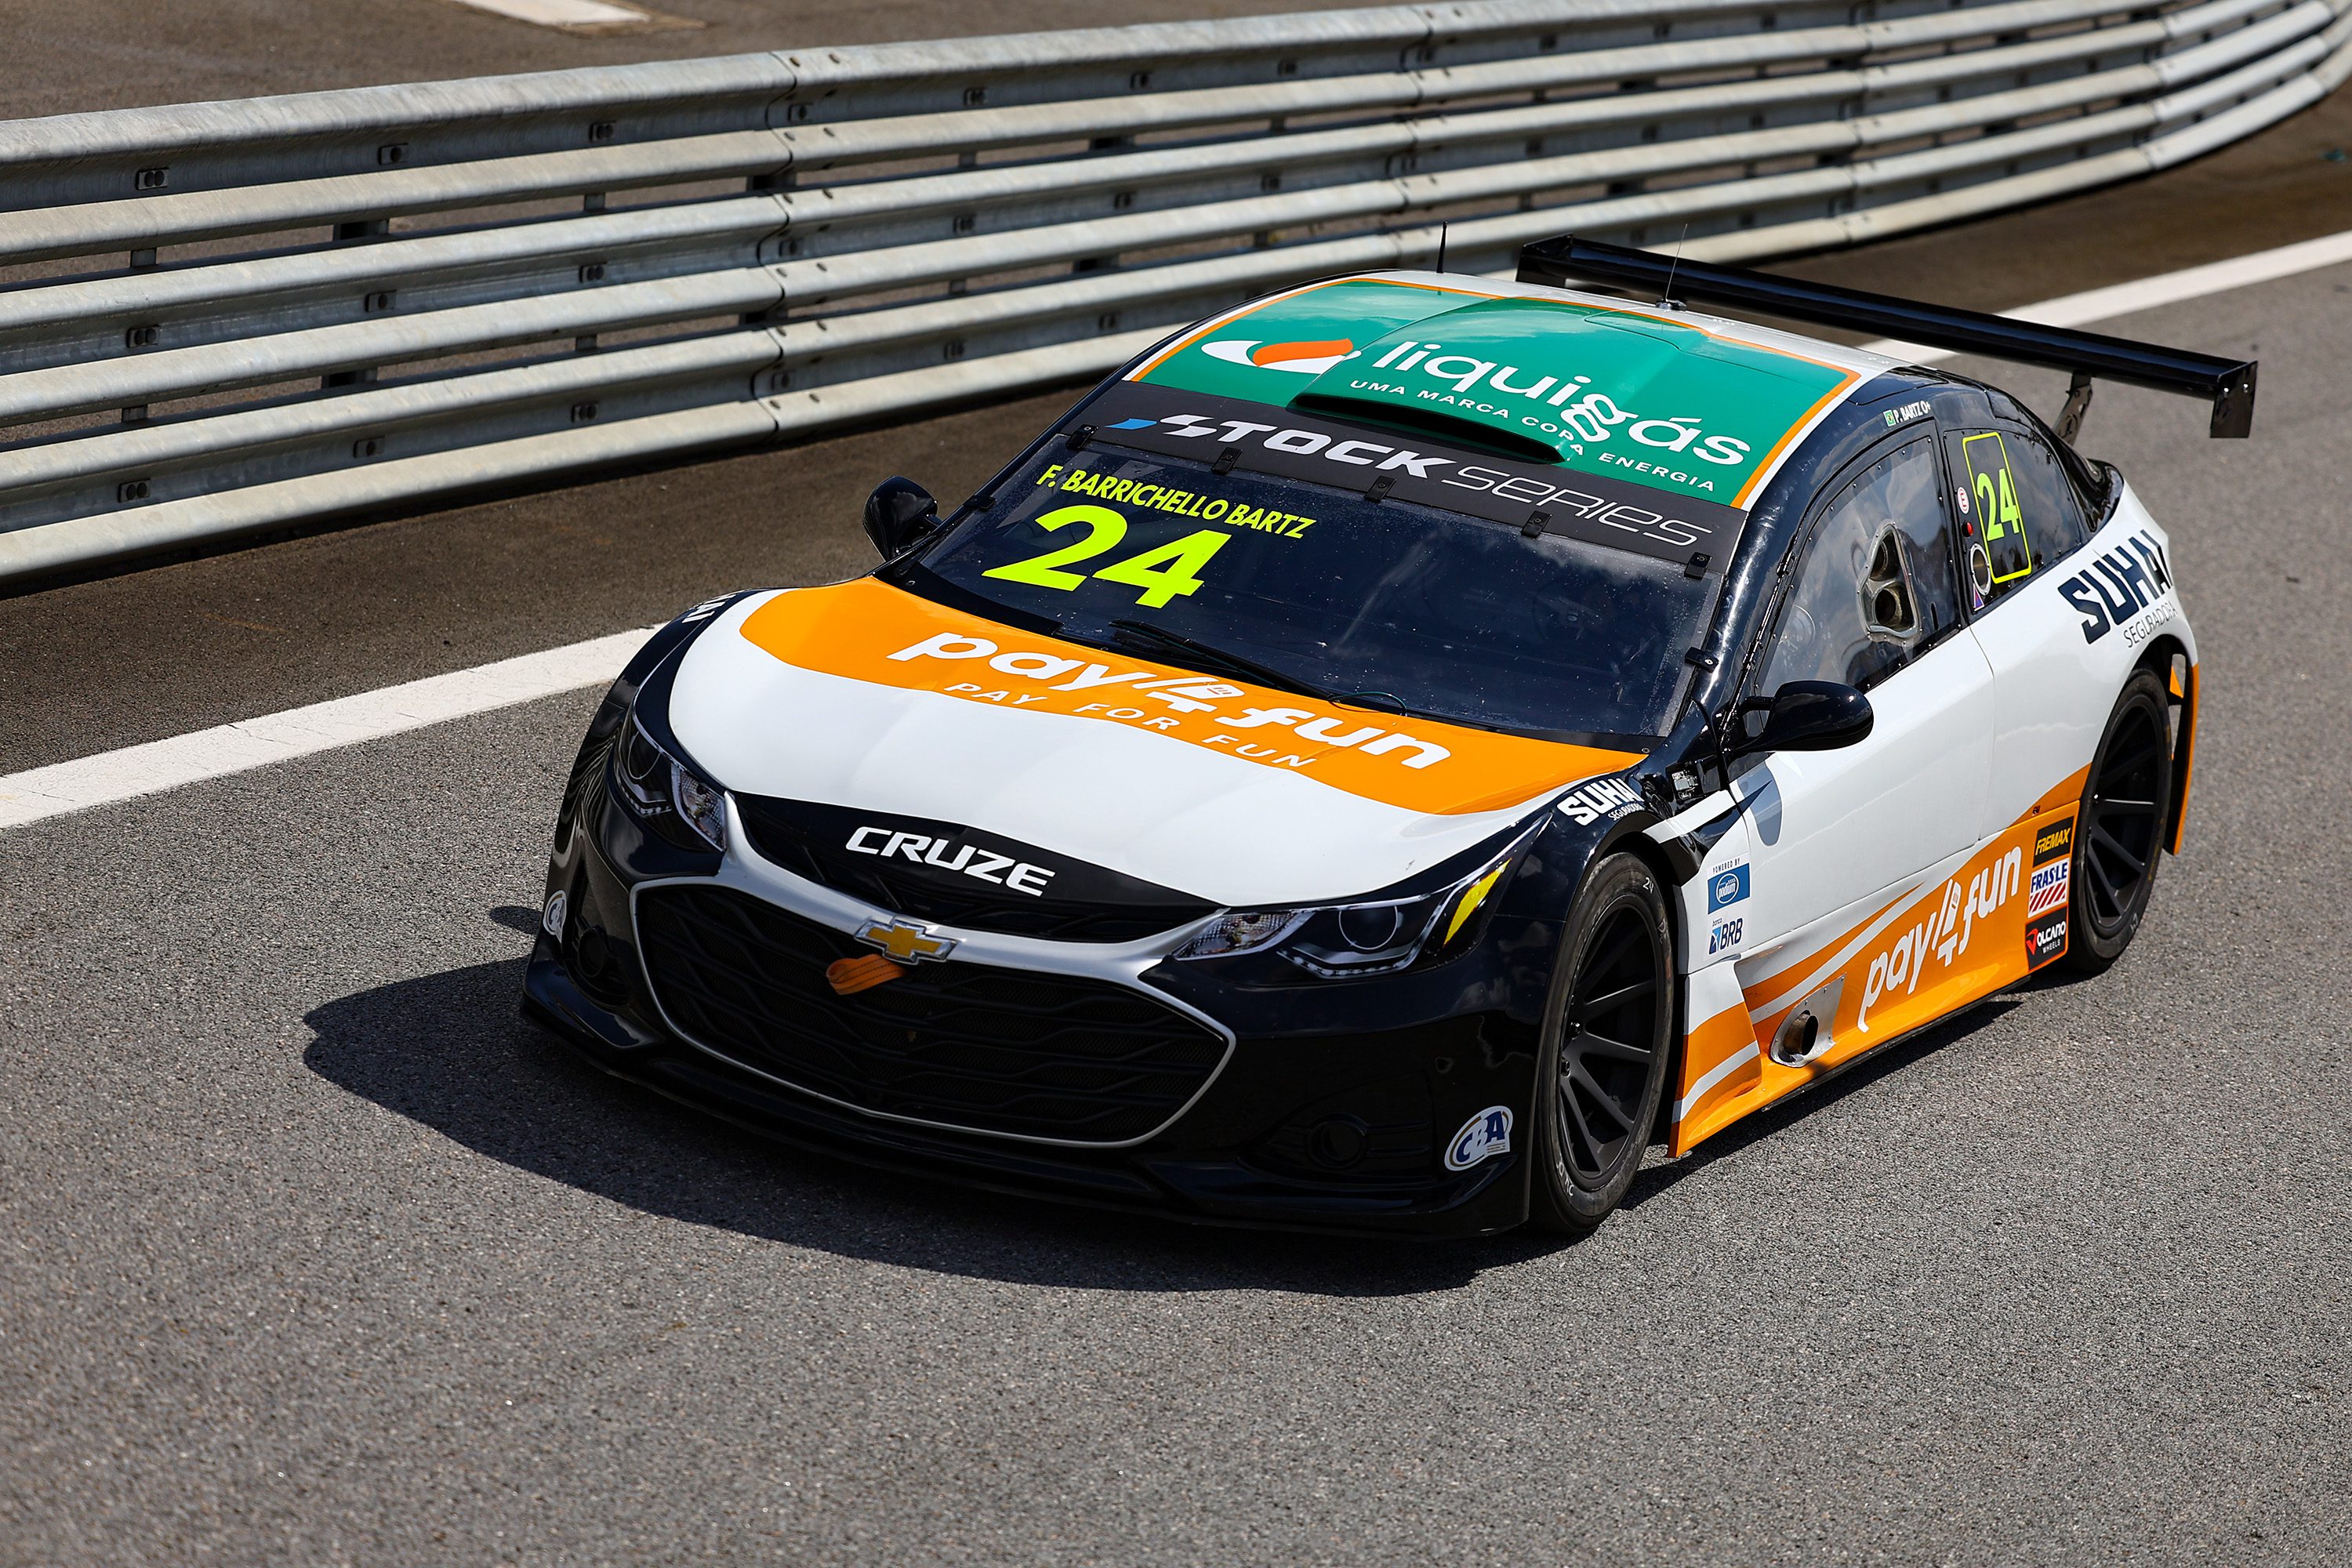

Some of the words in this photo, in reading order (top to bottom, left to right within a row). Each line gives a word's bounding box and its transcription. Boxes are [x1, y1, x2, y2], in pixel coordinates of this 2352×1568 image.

[1349, 379, 1406, 395] UMA
[1417, 390, 1510, 419] MARCA
[1521, 416, 1584, 456] COPA
[1598, 452, 1715, 492] ENERGIA
[1371, 340, 1751, 466] liquigás
[1900, 401, 1923, 421] BARTZ
[1159, 414, 1457, 479] STOCK
[1036, 464, 1064, 488] F.
[1061, 470, 1229, 521] BARRICHELLO
[1224, 504, 1317, 539] BARTZ
[1976, 468, 2020, 542] 24
[982, 504, 1232, 609] 24
[944, 683, 1048, 706] PAY
[1073, 702, 1181, 731] FOR
[1201, 734, 1317, 768] FUN
[845, 826, 1056, 897] CRUZE
[1712, 860, 1733, 874] POWERED
[1735, 858, 1740, 866] BY
[2035, 828, 2071, 856] FREMAX
[1719, 917, 1743, 949] BRB
[2042, 938, 2061, 954] WHEELS
[1456, 1110, 1506, 1163] CBA
